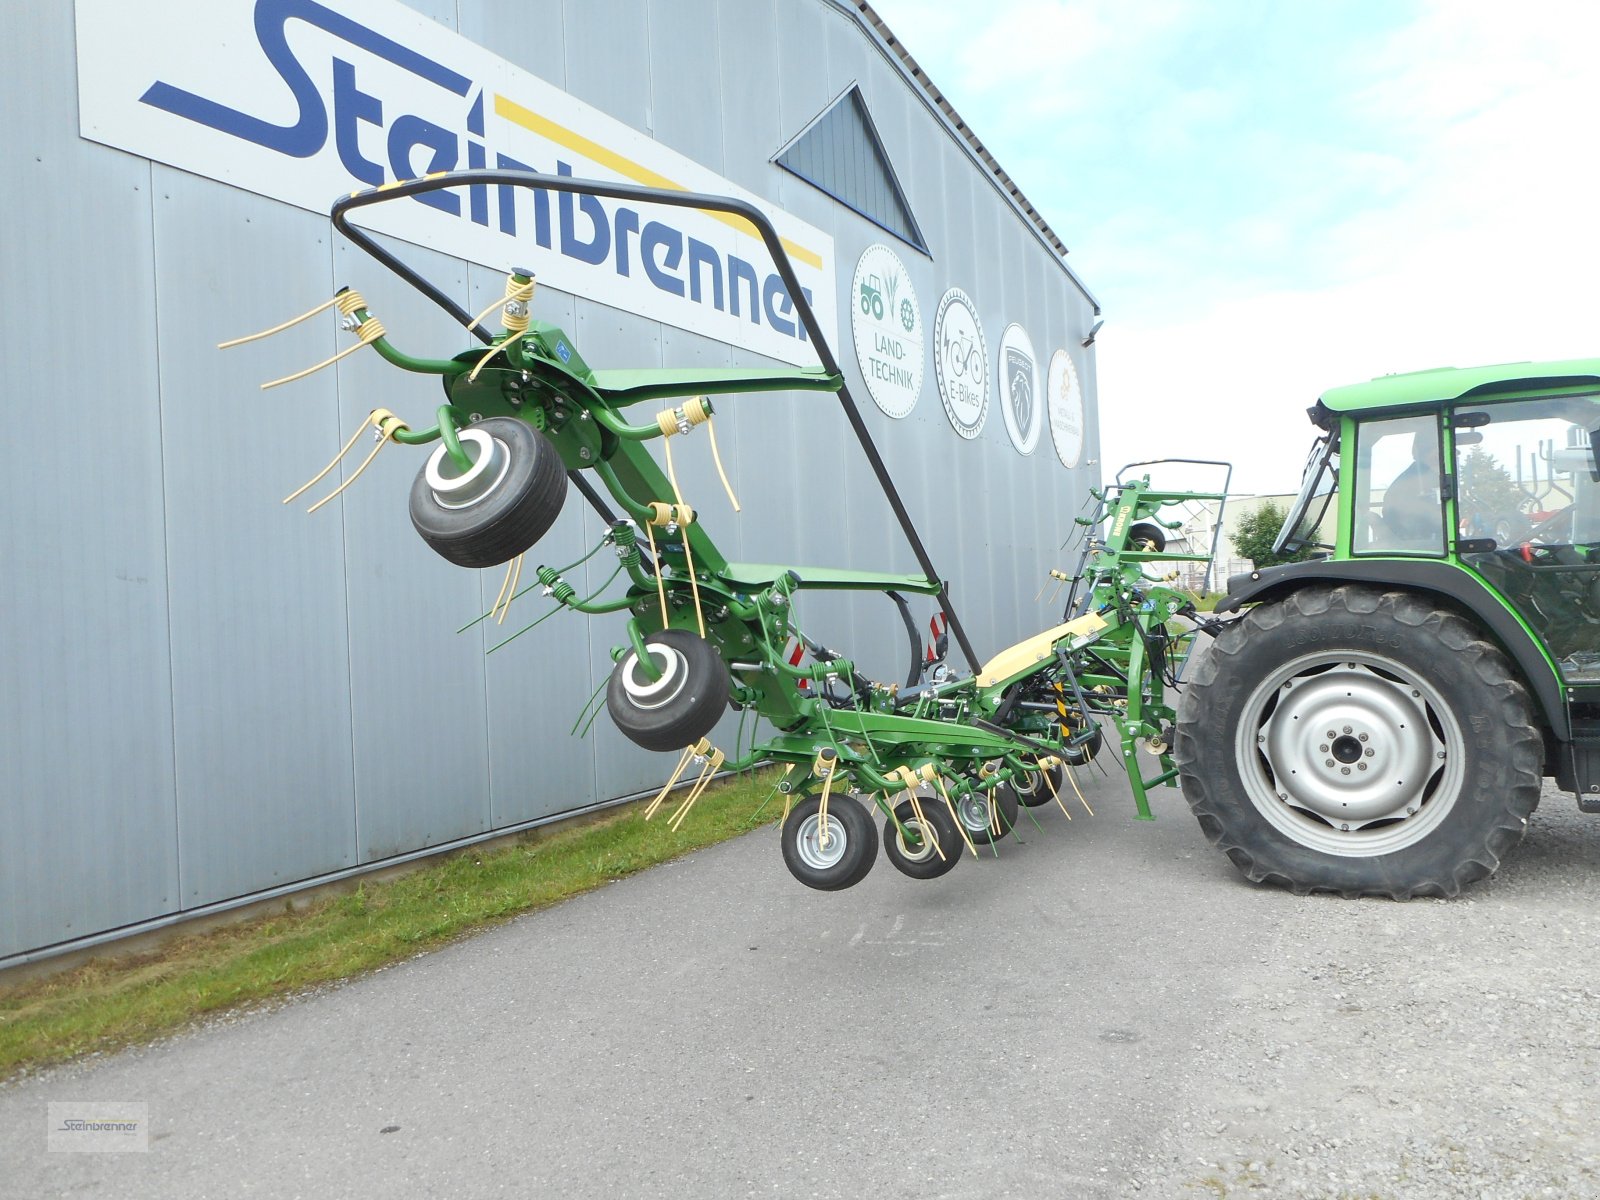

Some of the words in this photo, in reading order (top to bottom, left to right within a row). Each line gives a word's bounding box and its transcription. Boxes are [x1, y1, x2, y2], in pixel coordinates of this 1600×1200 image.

[874, 332, 906, 360] LAND-
[869, 357, 913, 391] TECHNIK
[950, 380, 980, 408] E-Bikes
